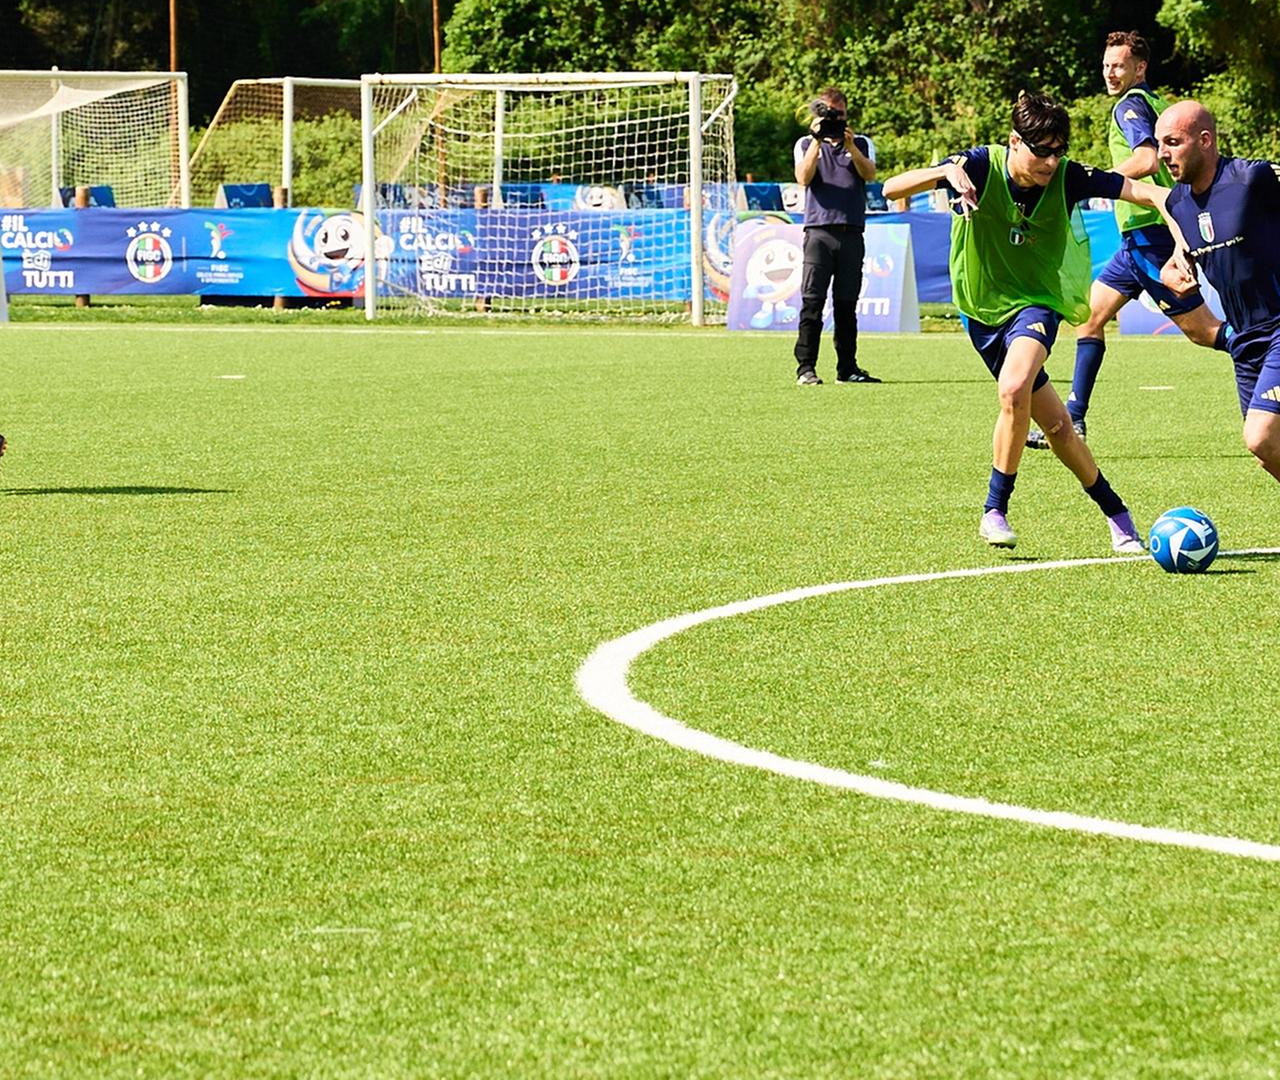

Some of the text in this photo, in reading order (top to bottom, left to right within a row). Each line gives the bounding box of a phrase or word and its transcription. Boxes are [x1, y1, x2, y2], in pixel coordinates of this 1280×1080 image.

[1, 216, 28, 232] #IL
[22, 271, 74, 289] TUTTI
[422, 274, 475, 291] TUTTI
